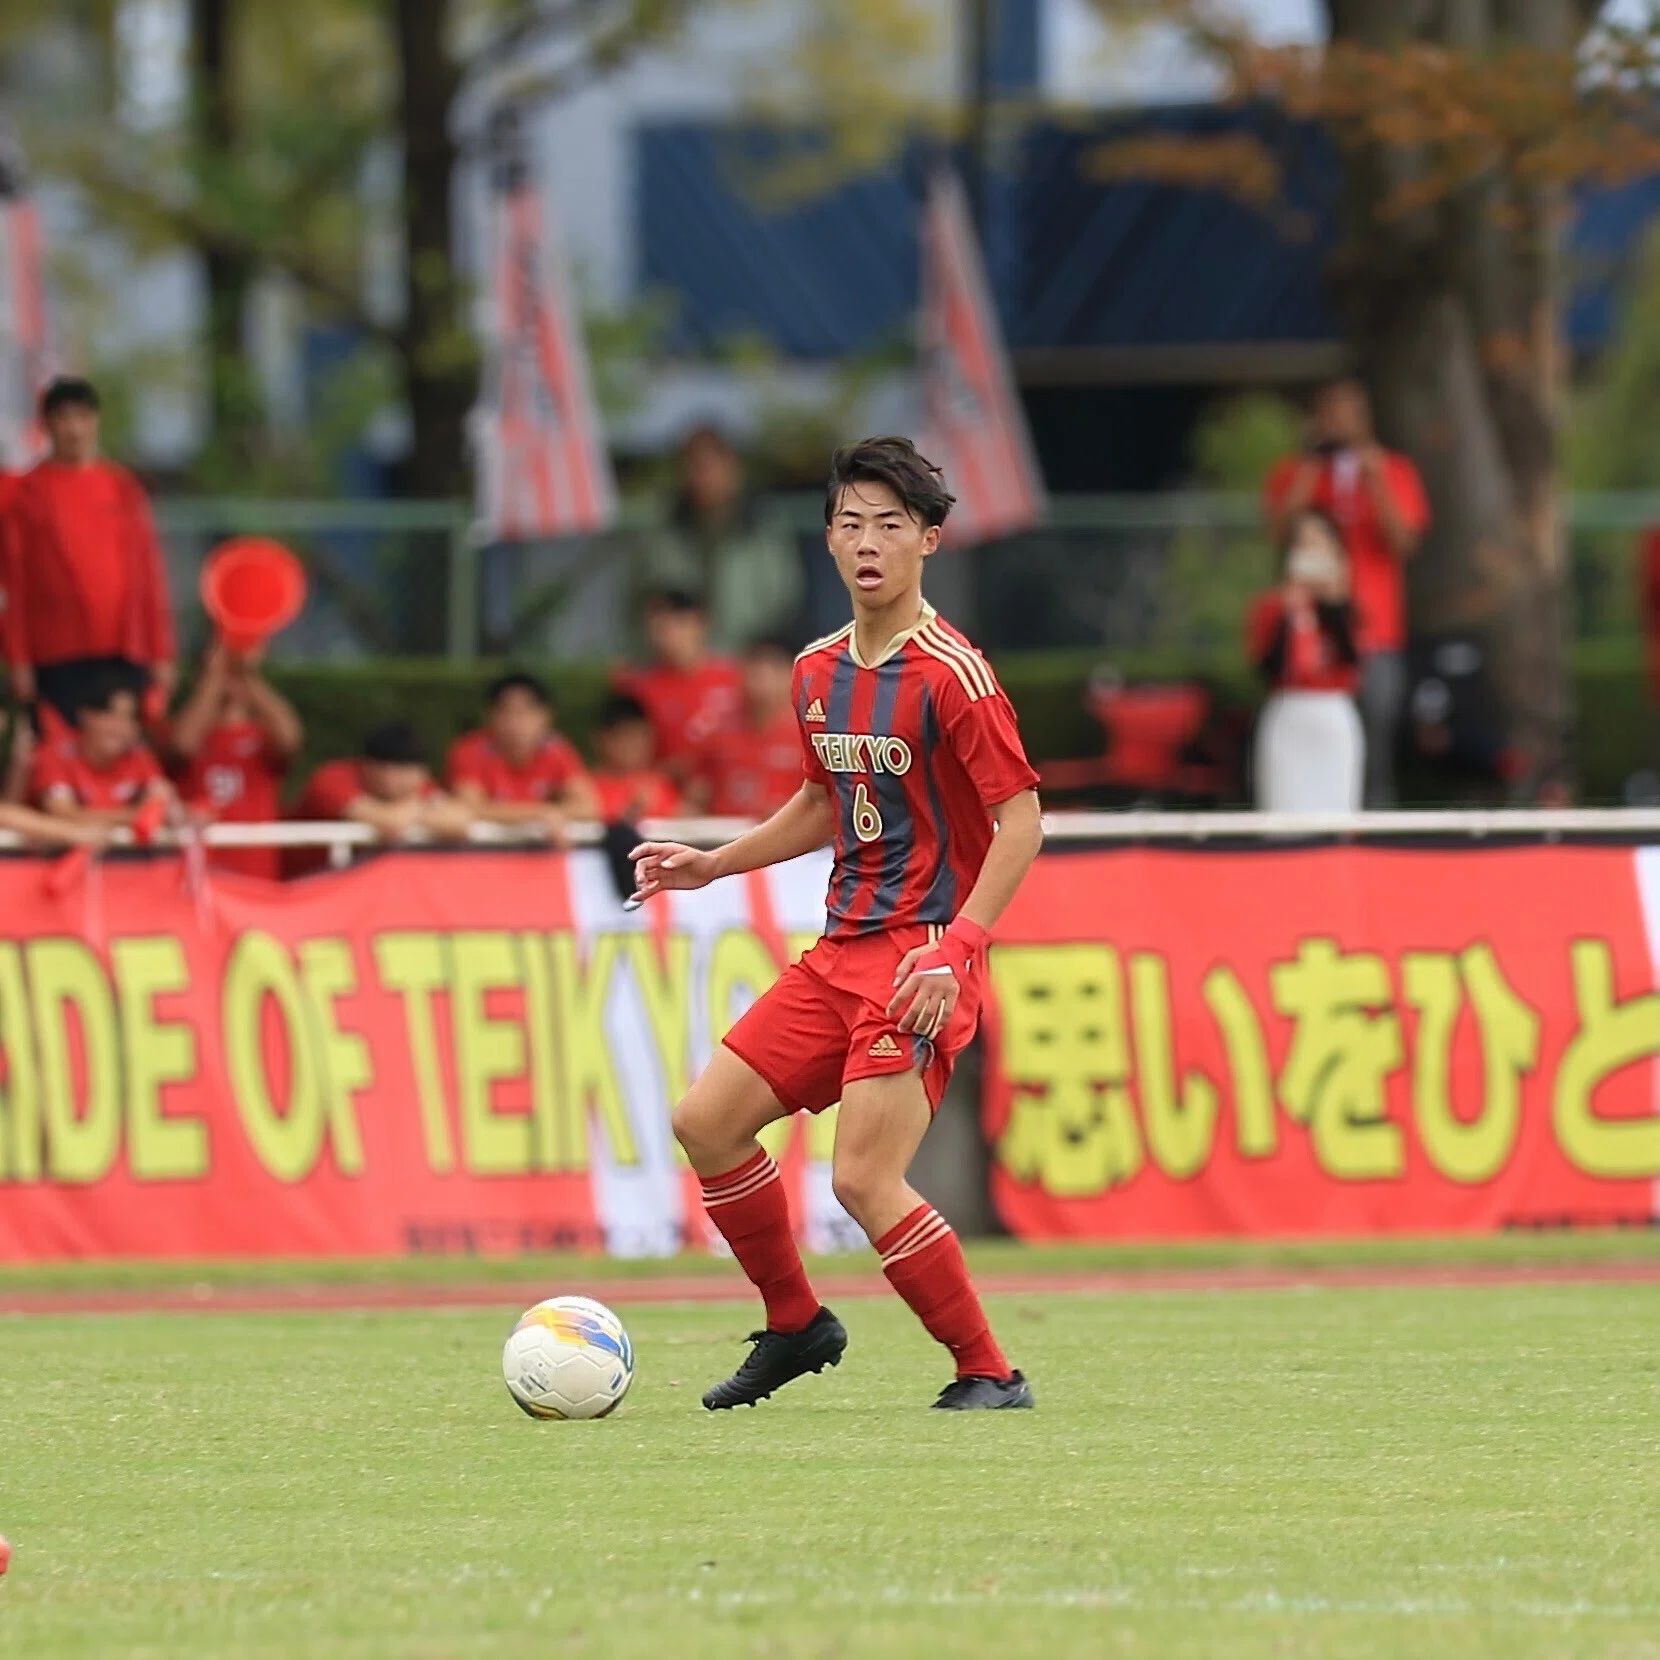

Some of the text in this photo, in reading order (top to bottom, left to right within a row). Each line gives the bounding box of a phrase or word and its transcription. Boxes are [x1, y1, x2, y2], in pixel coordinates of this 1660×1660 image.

[811, 733, 912, 776] TEIKYO
[853, 783, 883, 842] 6
[0, 935, 212, 1184] IDE
[222, 928, 374, 1184] OF
[988, 938, 1660, 1197] 思いをひと
